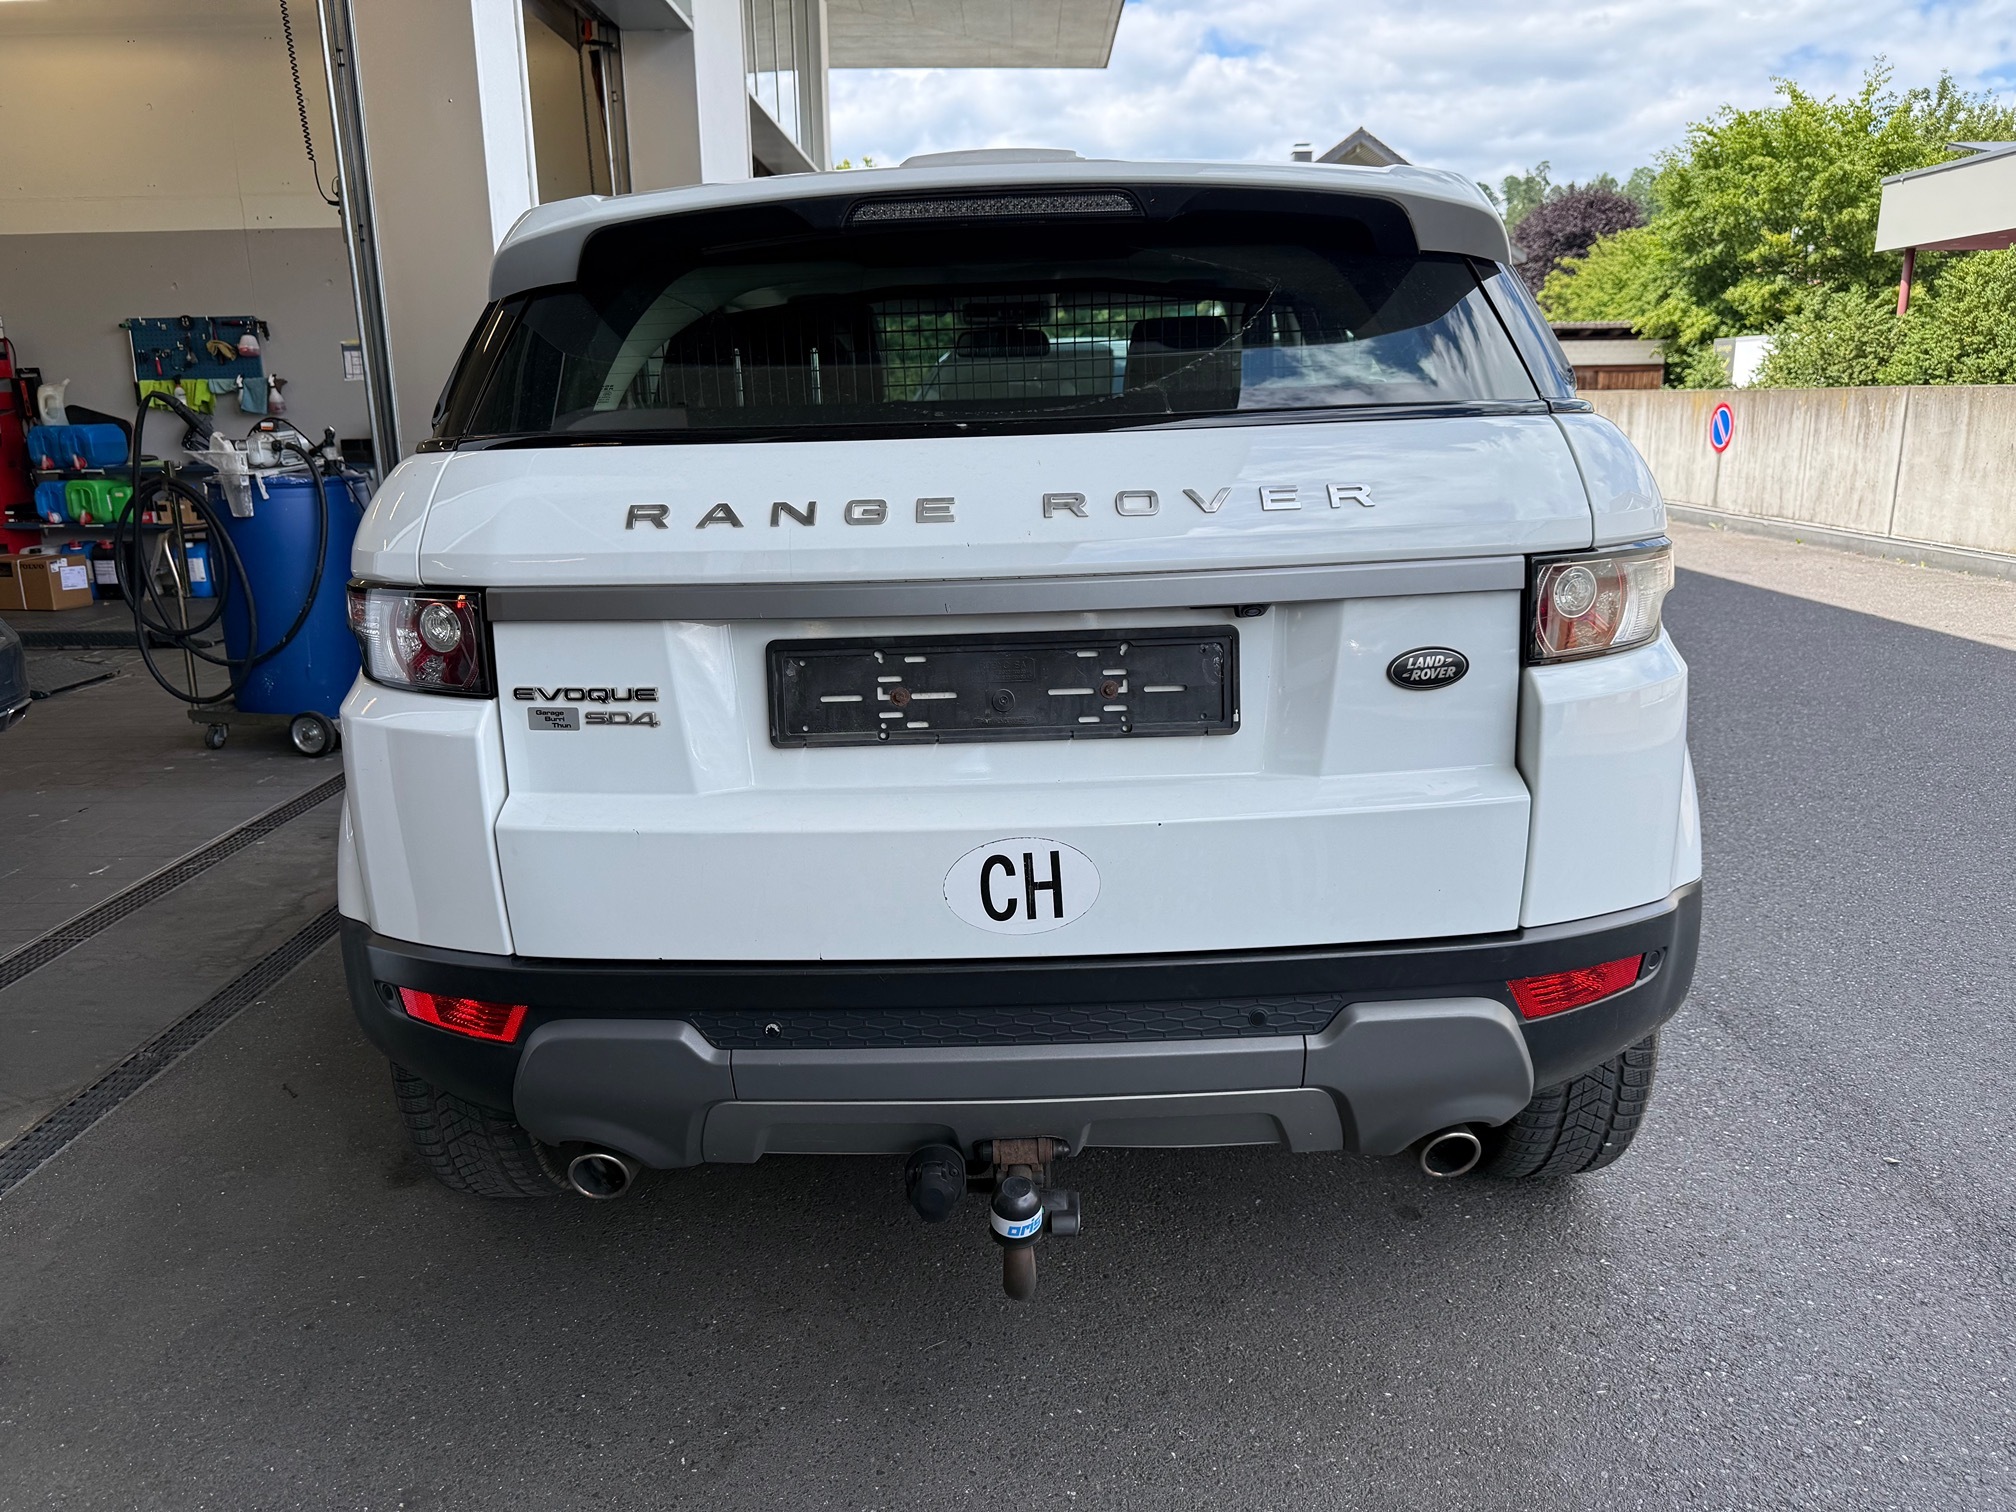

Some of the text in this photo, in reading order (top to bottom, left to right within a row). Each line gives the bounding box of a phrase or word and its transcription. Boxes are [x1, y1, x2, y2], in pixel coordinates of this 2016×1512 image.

[625, 483, 1376, 530] RANGE ROVER
[1407, 655, 1444, 669] LAND
[1410, 666, 1456, 681] ROVER
[513, 687, 659, 704] EVOQUE
[535, 709, 565, 717] Garage
[584, 711, 660, 728] SD4
[980, 850, 1064, 922] CH
